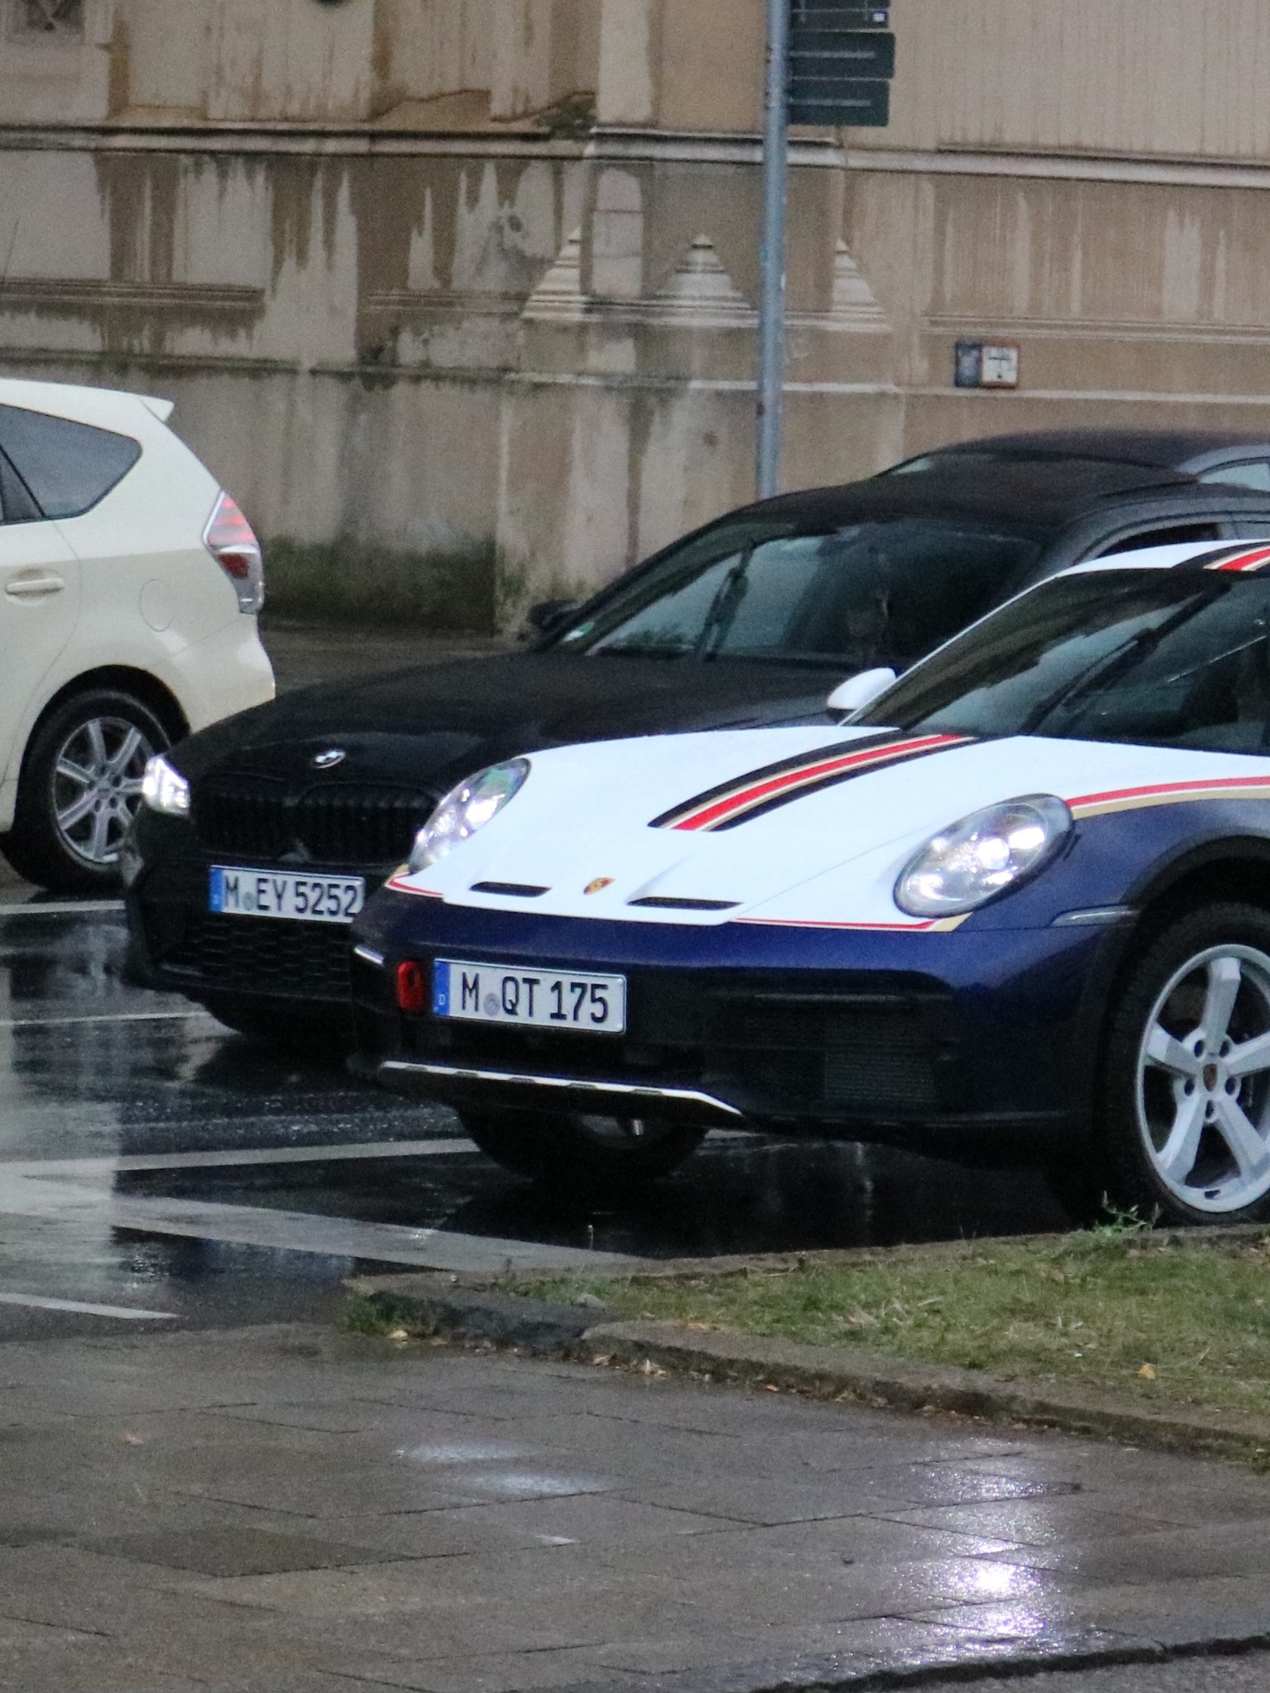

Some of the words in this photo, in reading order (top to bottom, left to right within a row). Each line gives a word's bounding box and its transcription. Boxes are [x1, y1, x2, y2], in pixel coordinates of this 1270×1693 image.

[224, 875, 240, 908] M
[255, 877, 287, 912] EY
[294, 880, 358, 918] 5252
[461, 971, 480, 1012] M
[501, 975, 541, 1018] QT
[550, 980, 610, 1024] 175
